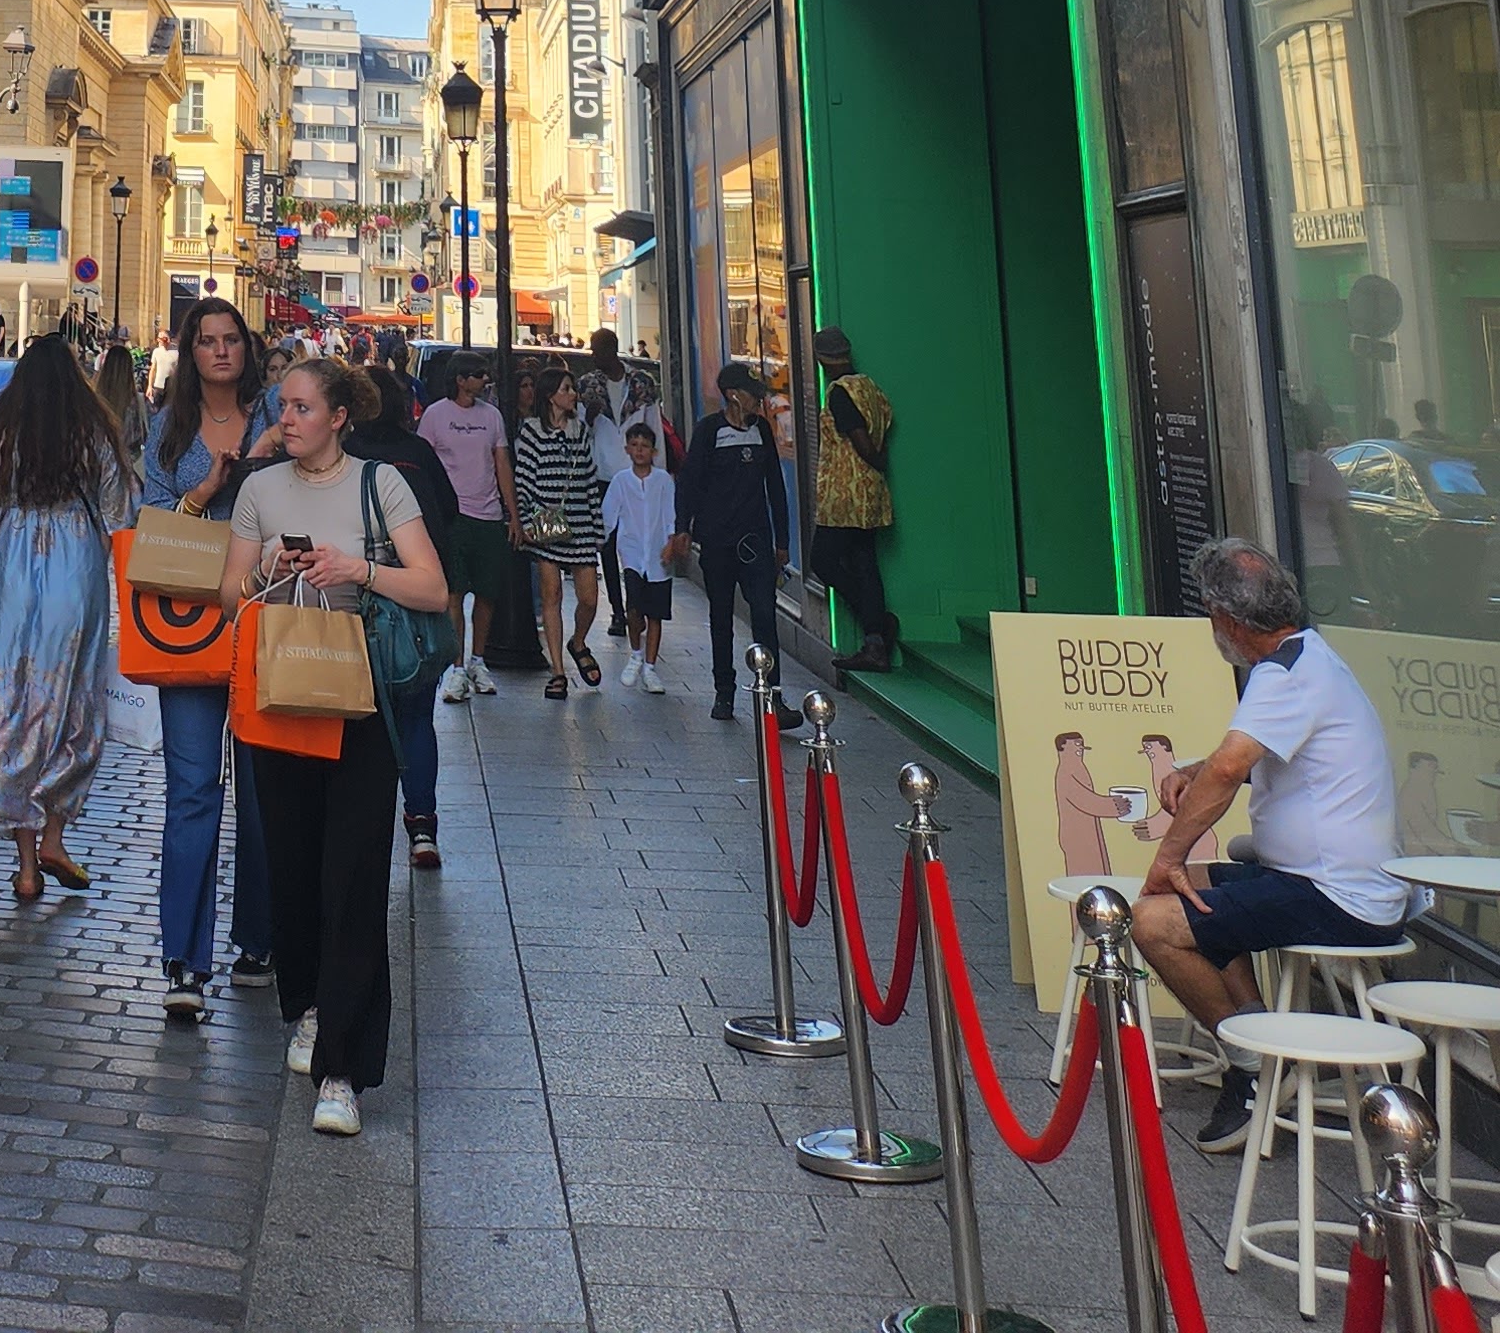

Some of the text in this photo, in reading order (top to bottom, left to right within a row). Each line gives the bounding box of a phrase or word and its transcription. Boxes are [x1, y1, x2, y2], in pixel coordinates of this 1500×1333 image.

[1057, 638, 1164, 668] BUDDY
[1061, 668, 1169, 698] BUDDY
[105, 687, 146, 708] MANGO
[1064, 701, 1175, 714] NUT BUTTER ATELIER
